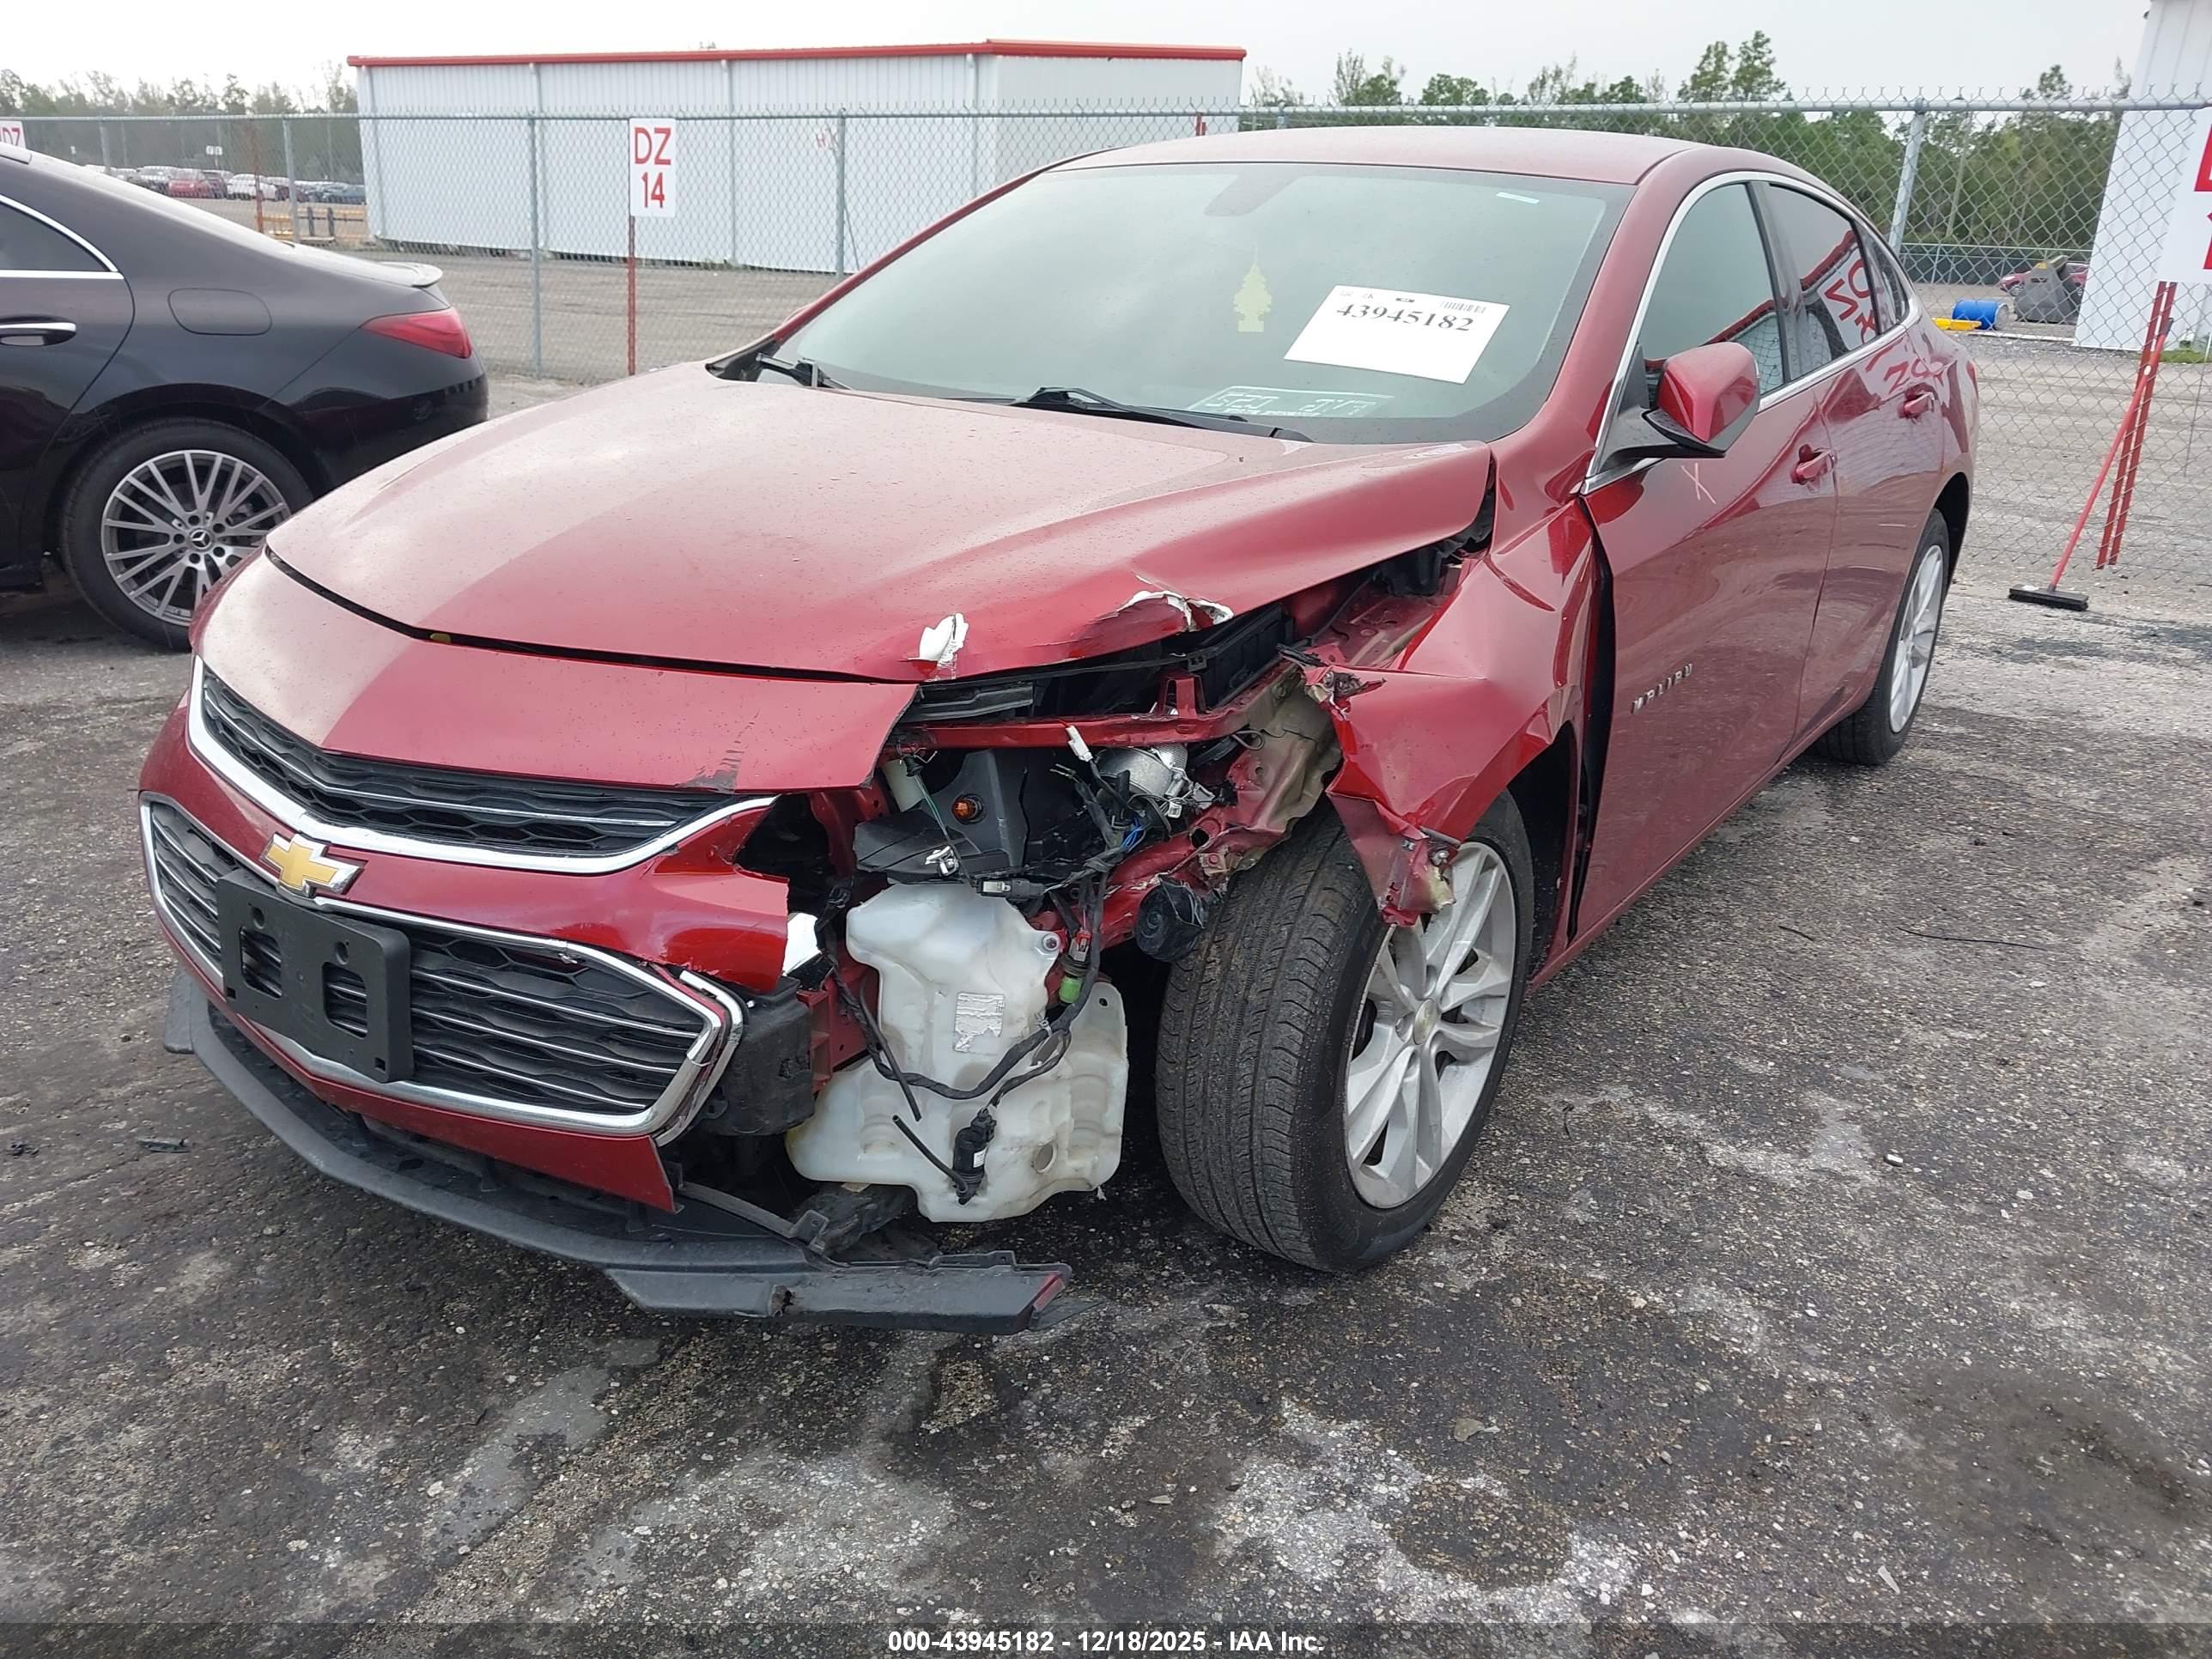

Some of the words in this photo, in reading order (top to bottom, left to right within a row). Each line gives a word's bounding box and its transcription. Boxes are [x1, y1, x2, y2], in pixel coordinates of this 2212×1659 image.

[634, 126, 672, 165] DZ
[641, 171, 665, 208] 14
[1336, 303, 1474, 331] 43945182
[1631, 663, 1692, 714] MALIBU
